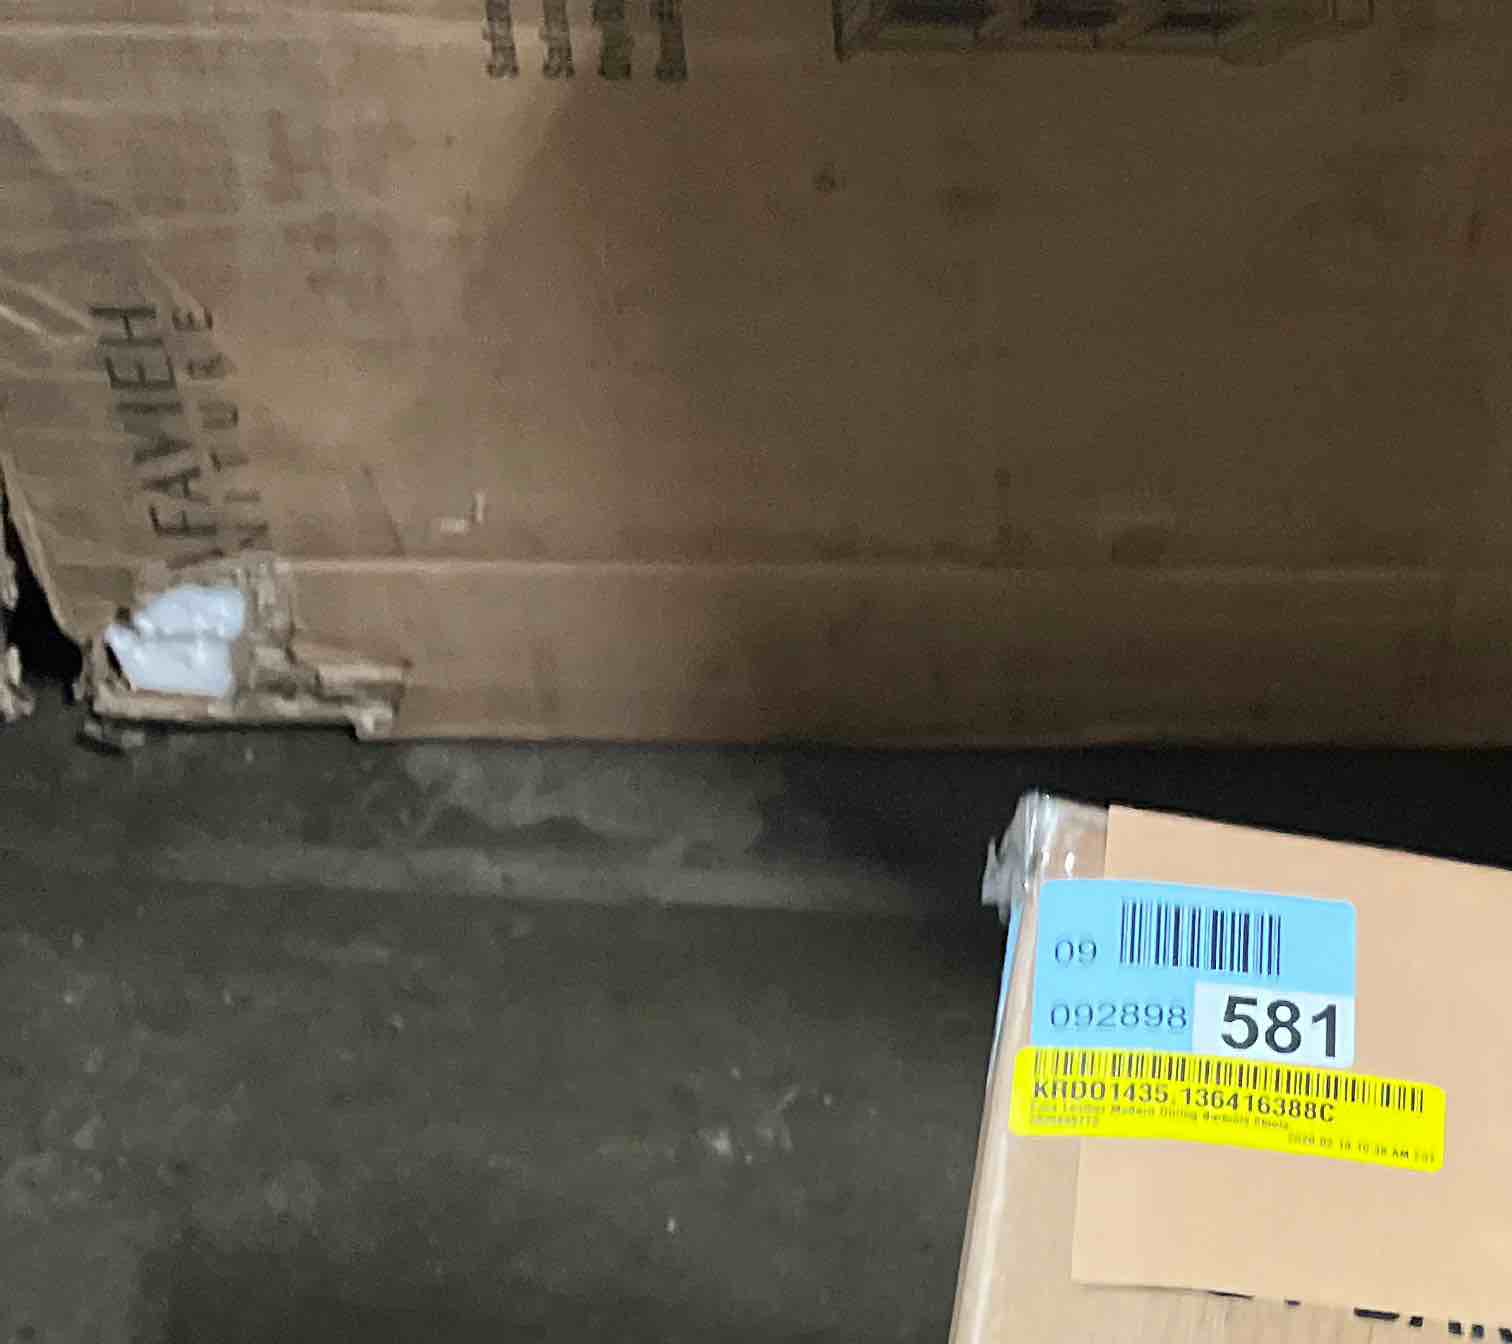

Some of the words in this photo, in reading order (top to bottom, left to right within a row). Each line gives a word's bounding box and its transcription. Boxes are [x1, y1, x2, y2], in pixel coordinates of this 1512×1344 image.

[1054, 937, 1098, 966] 09
[1050, 1001, 1189, 1032] 092898
[1221, 995, 1338, 1059] 581
